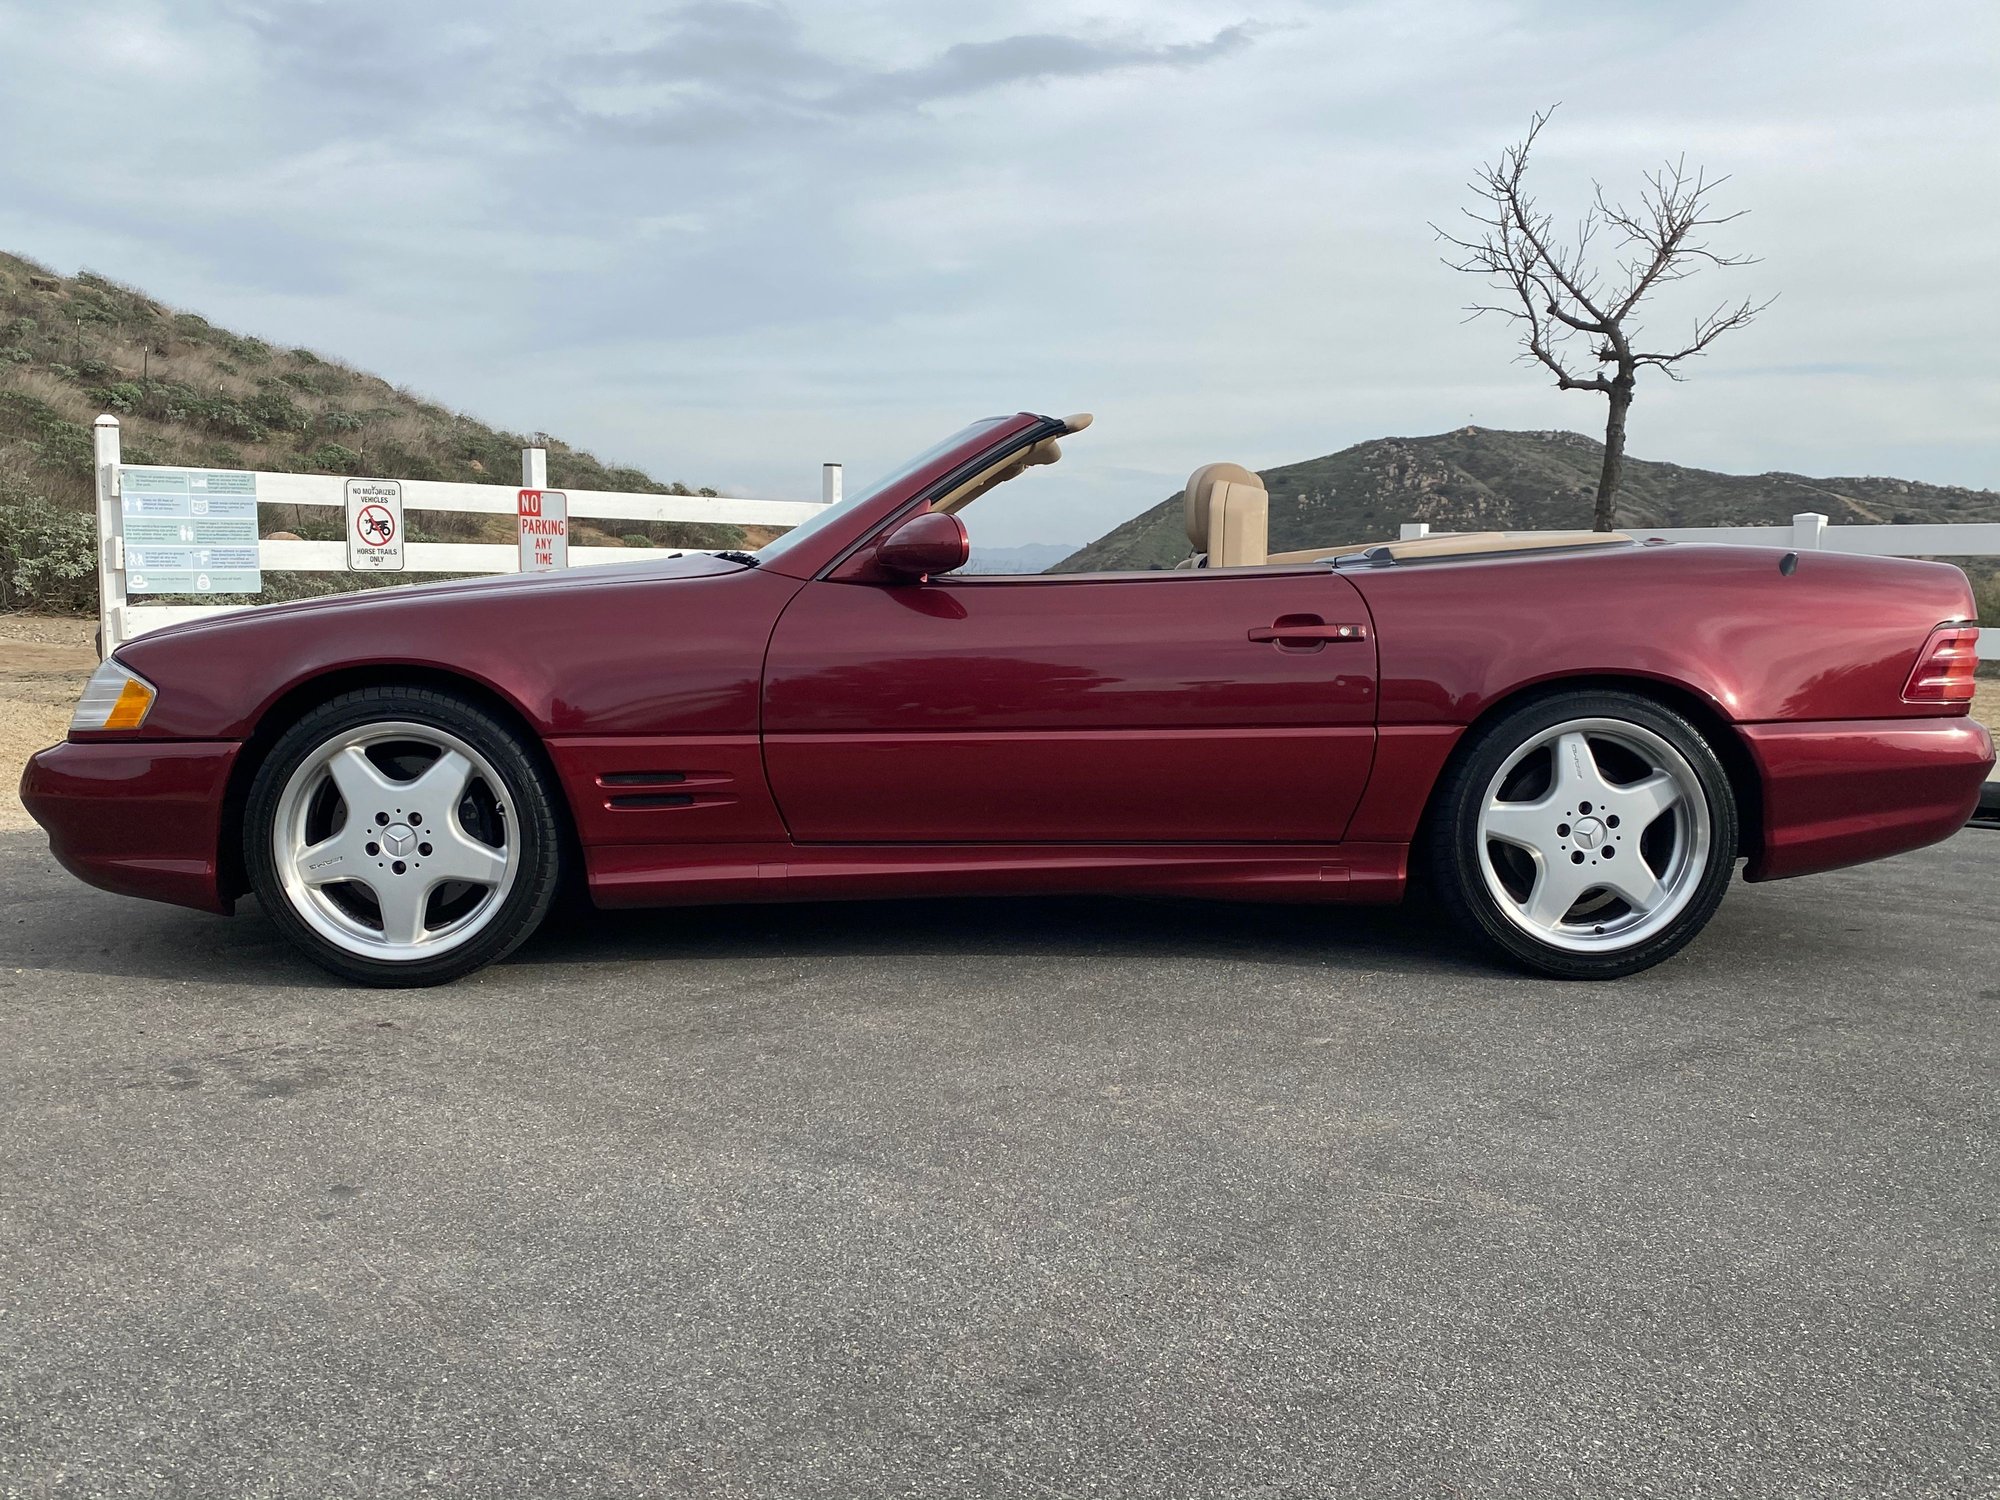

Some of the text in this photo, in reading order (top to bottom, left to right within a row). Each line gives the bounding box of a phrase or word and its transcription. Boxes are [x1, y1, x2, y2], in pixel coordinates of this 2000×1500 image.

[362, 488, 396, 496] MOTORIZED
[361, 496, 389, 504] VEHICLES
[521, 494, 538, 513] NO
[522, 518, 564, 536] PARKING
[535, 538, 552, 550] ANY
[535, 552, 553, 565] TIME
